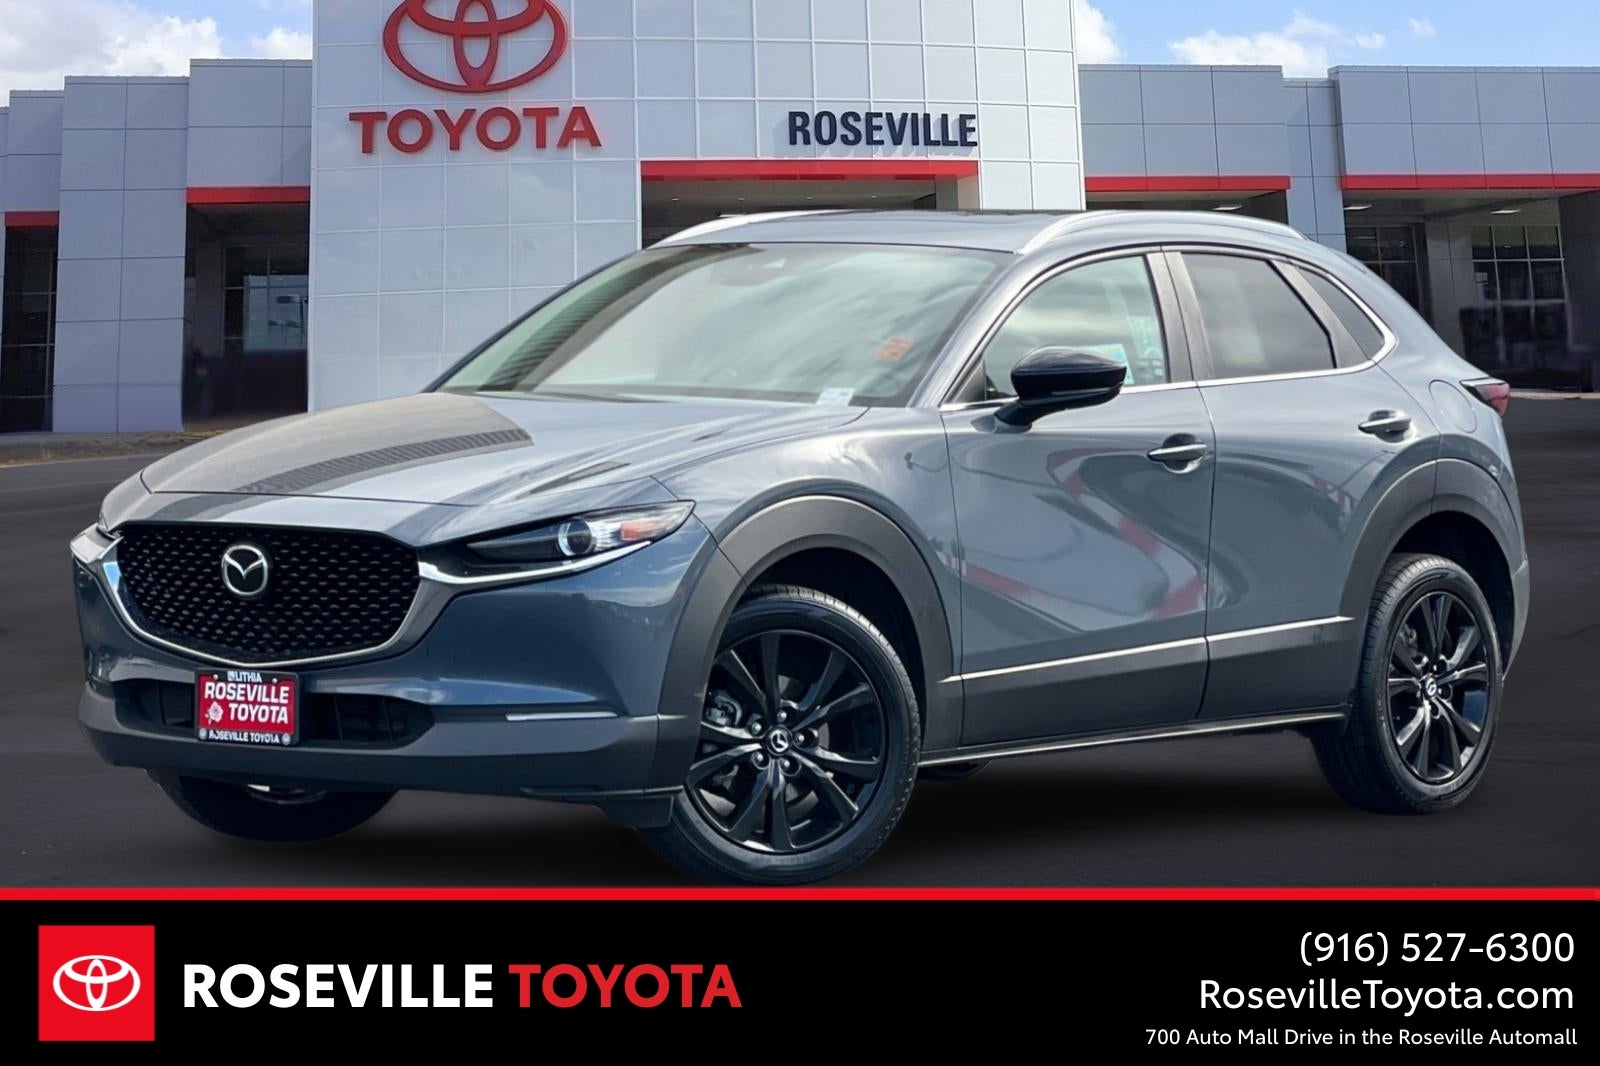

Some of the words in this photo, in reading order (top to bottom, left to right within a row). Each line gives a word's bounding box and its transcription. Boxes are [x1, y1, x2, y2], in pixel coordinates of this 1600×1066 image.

[349, 105, 602, 154] TOYOTA
[788, 110, 978, 148] ROSEVILLE
[235, 671, 262, 683] LITHIA
[204, 682, 290, 704] ROSEVILLE
[228, 703, 289, 724] TOYOTA
